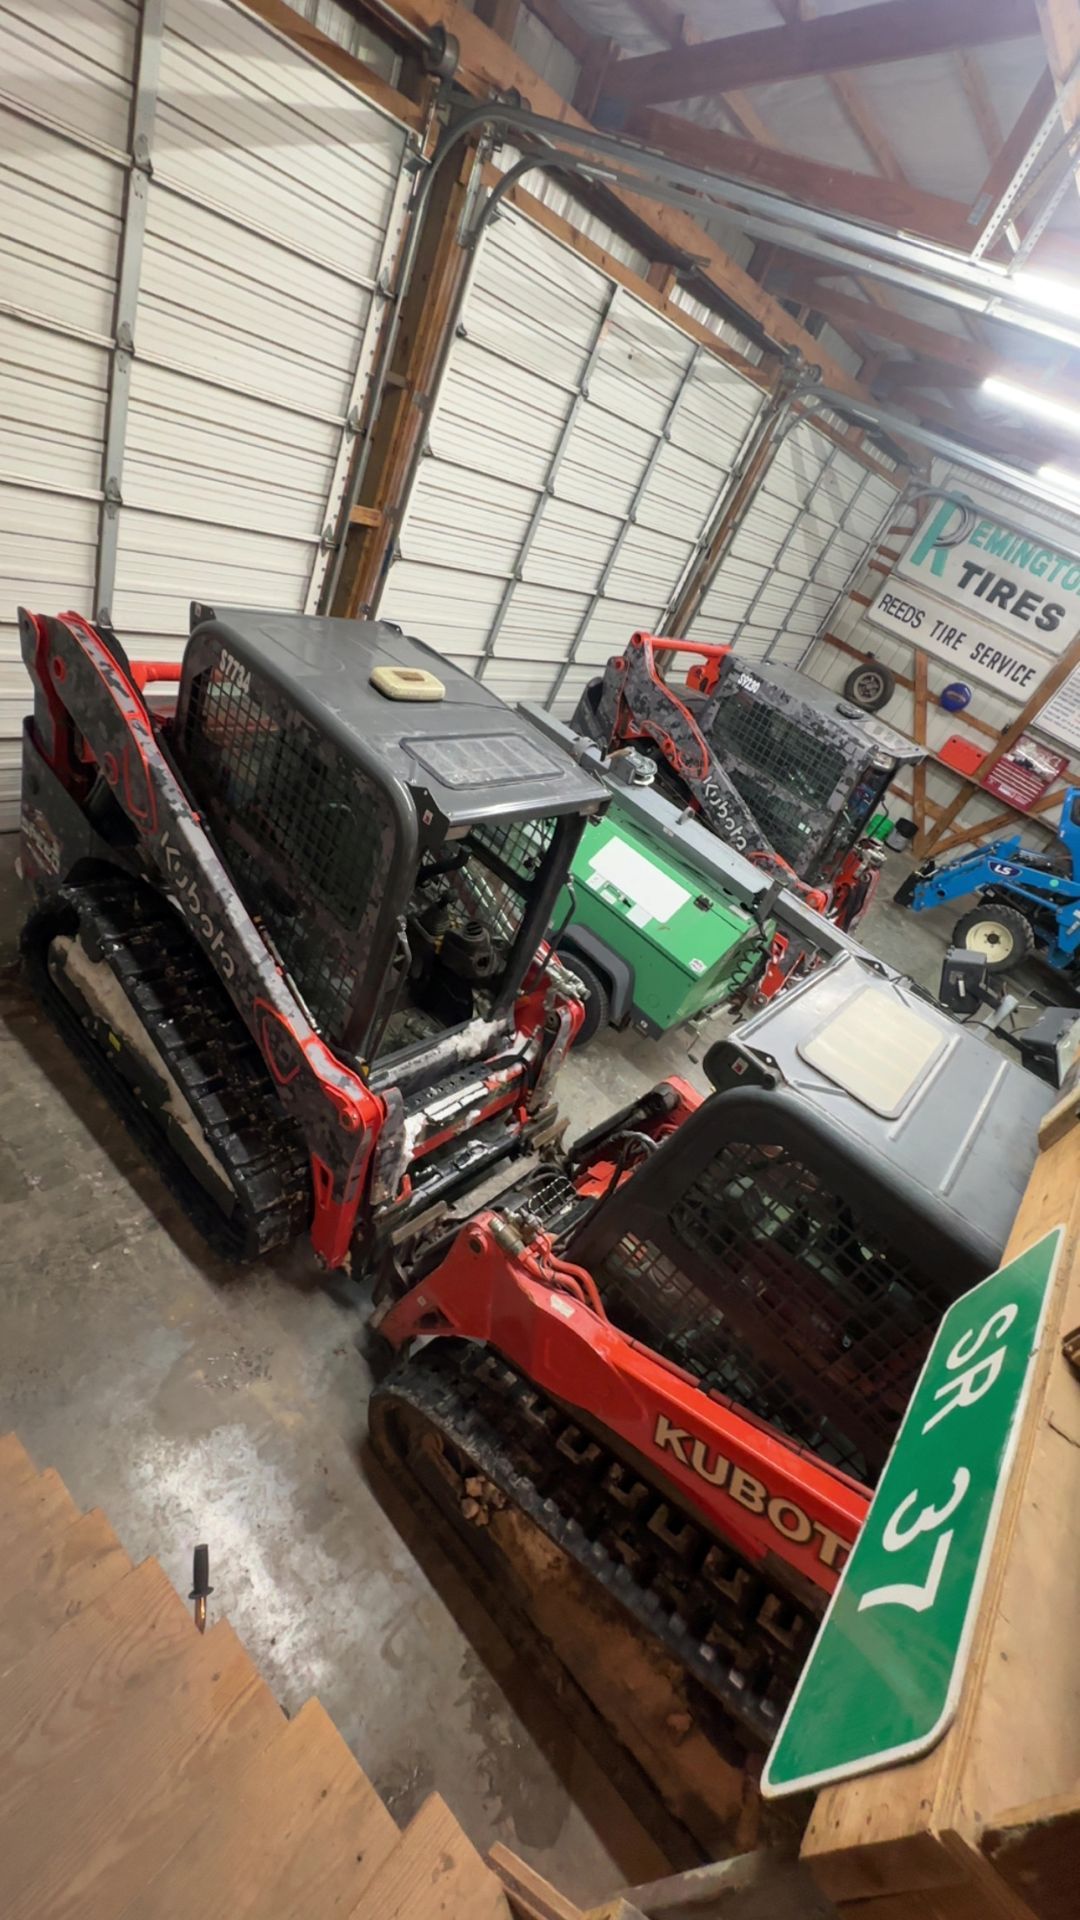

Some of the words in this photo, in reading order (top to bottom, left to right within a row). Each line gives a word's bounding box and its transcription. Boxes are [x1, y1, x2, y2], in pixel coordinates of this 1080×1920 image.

[909, 490, 1080, 597] REMINGTO
[957, 560, 1066, 632] TIRES
[930, 620, 967, 651] TIRE
[970, 642, 1036, 687] SERVICE
[995, 865, 1012, 875] LS
[922, 1303, 1018, 1435] SR
[652, 1415, 852, 1574] KUBOT
[857, 1466, 970, 1613] 37
